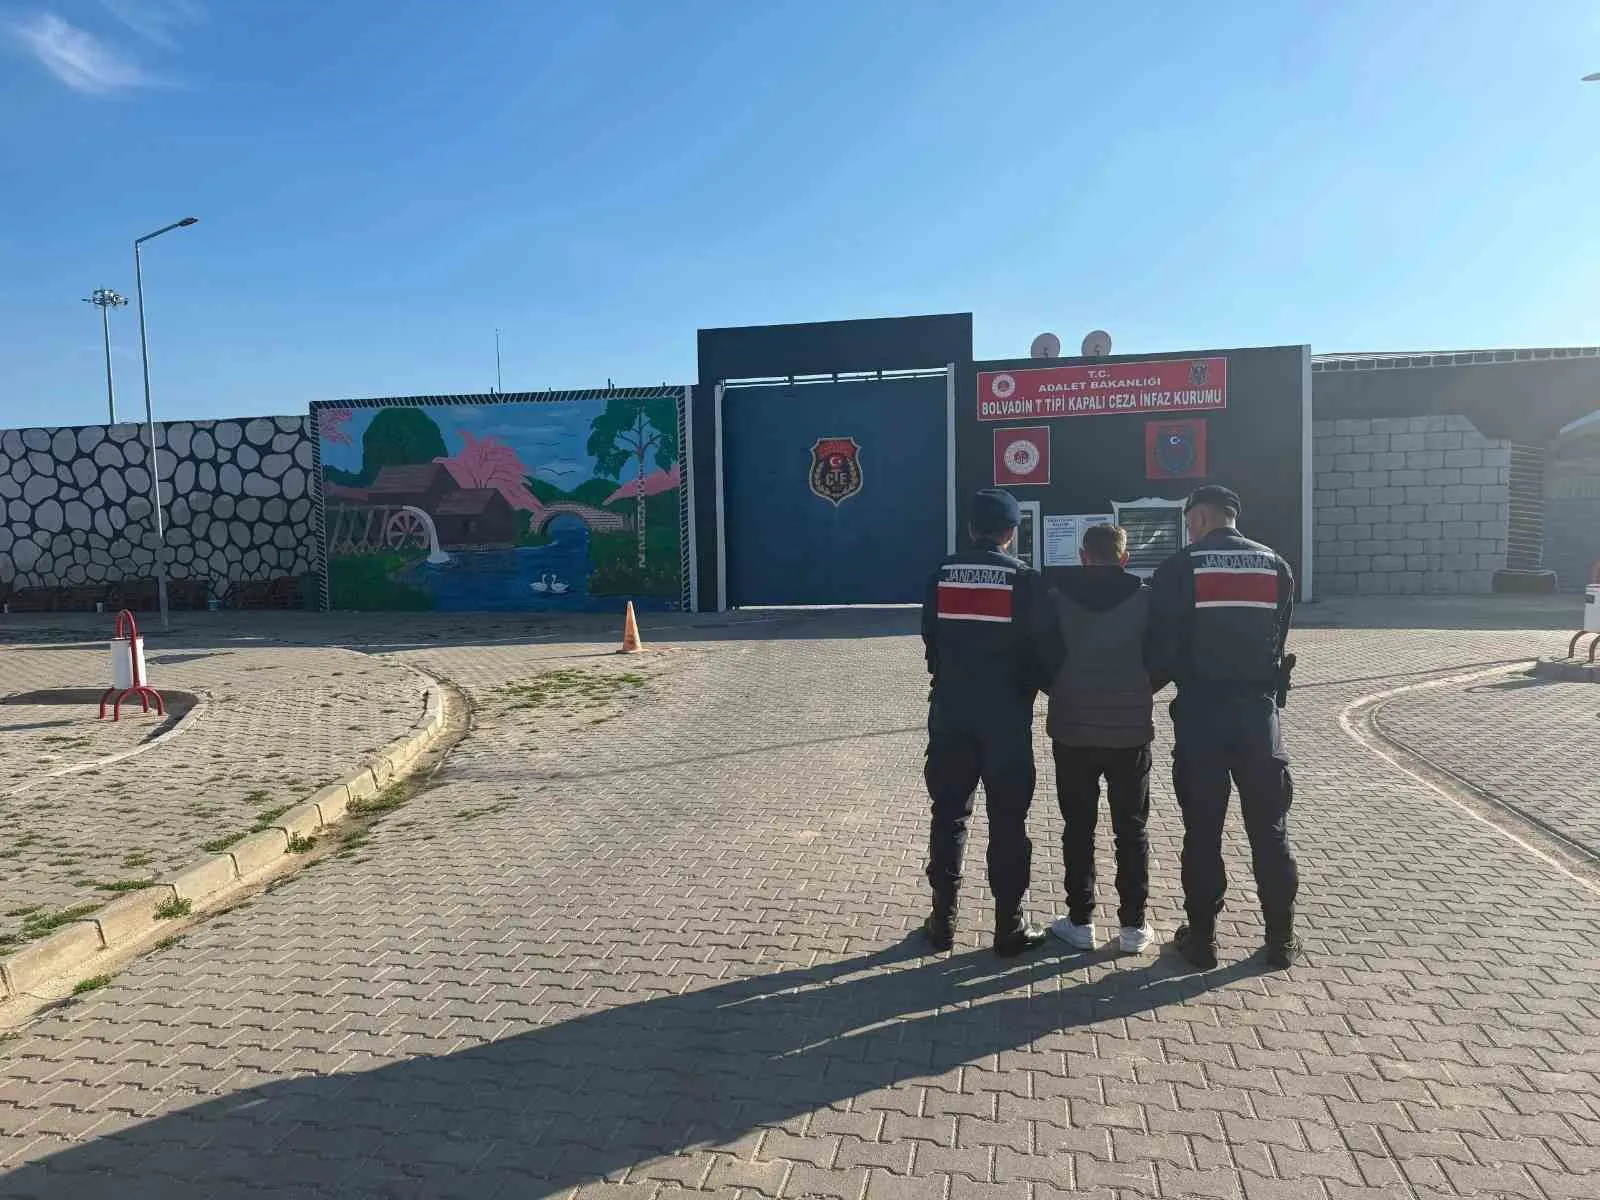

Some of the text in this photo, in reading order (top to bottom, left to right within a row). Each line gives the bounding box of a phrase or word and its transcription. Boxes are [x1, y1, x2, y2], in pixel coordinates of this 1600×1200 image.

[1088, 370, 1111, 379] T.C.
[1039, 382, 1087, 393] ADALET
[982, 388, 1222, 416] BOLVADİN T TİPİ KAPALI CEZA İNFAZ KURUMU
[1202, 553, 1272, 569] JANDARMA
[945, 568, 1007, 585] JANDARMA
